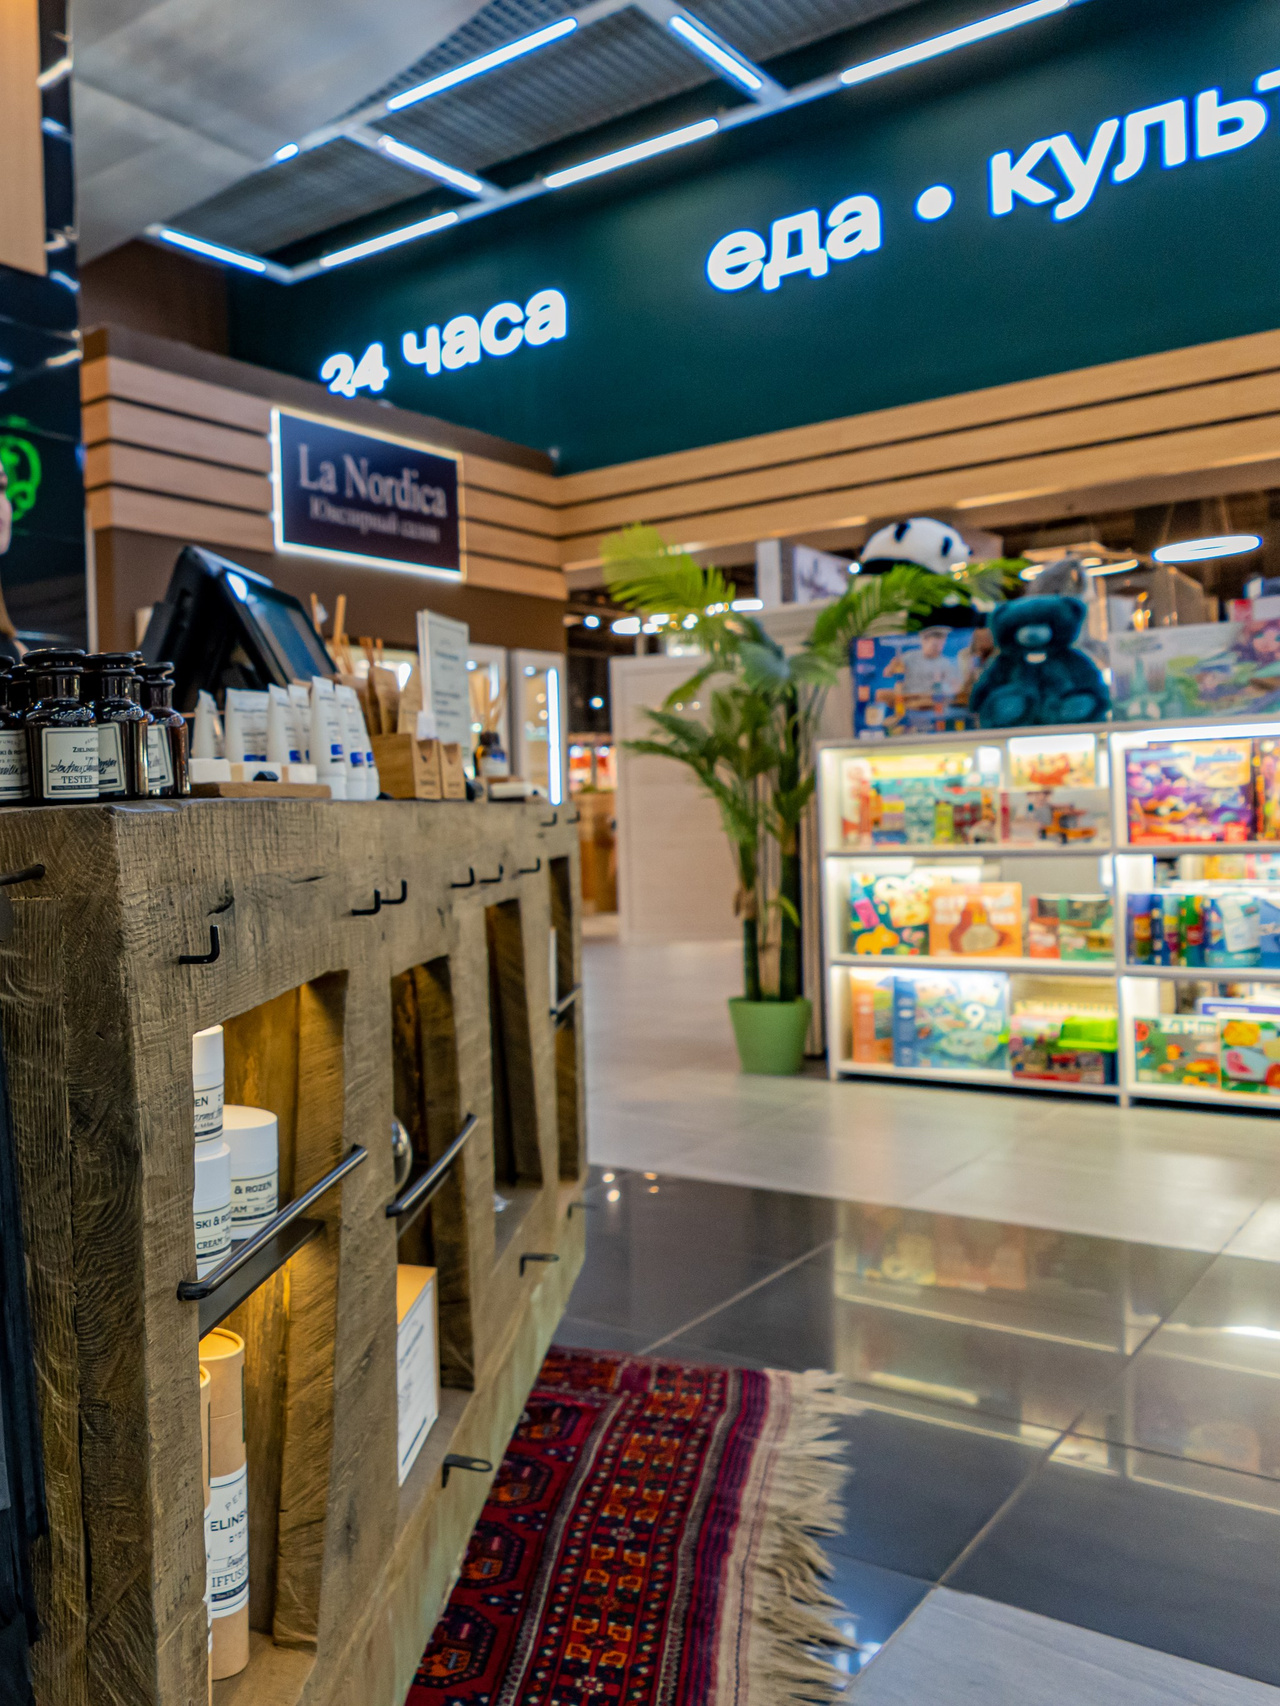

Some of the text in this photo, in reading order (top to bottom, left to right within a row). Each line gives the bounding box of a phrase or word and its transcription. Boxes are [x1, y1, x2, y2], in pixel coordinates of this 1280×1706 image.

[705, 193, 882, 291] еда
[320, 288, 568, 398] 24 часа
[299, 443, 448, 519] La Nordica
[61, 776, 93, 784] TESTER
[245, 1181, 272, 1194] ROZEN
[196, 1237, 223, 1250] CREAM
